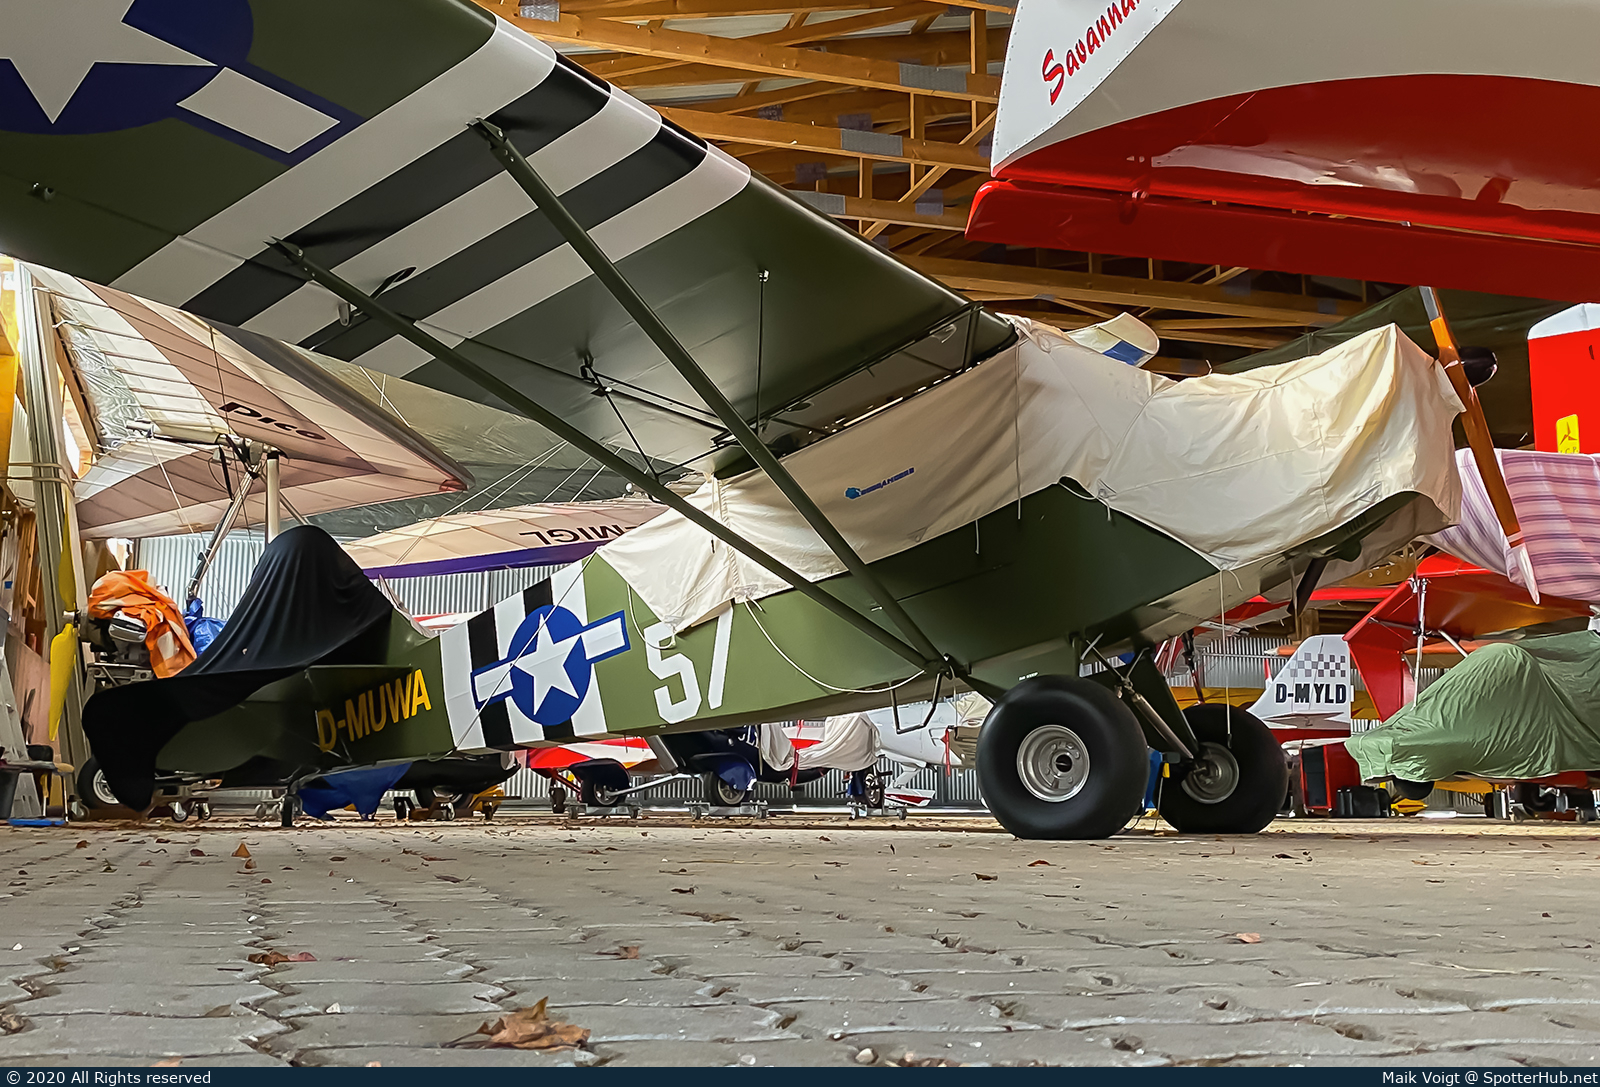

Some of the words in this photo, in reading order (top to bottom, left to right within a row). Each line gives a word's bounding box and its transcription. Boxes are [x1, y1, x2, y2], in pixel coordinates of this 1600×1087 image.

[1042, 0, 1140, 106] Savanna
[519, 524, 637, 545] -MIGL
[643, 606, 734, 725] 57
[1275, 683, 1347, 704] D-MYLD
[317, 668, 432, 753] D-MUWA
